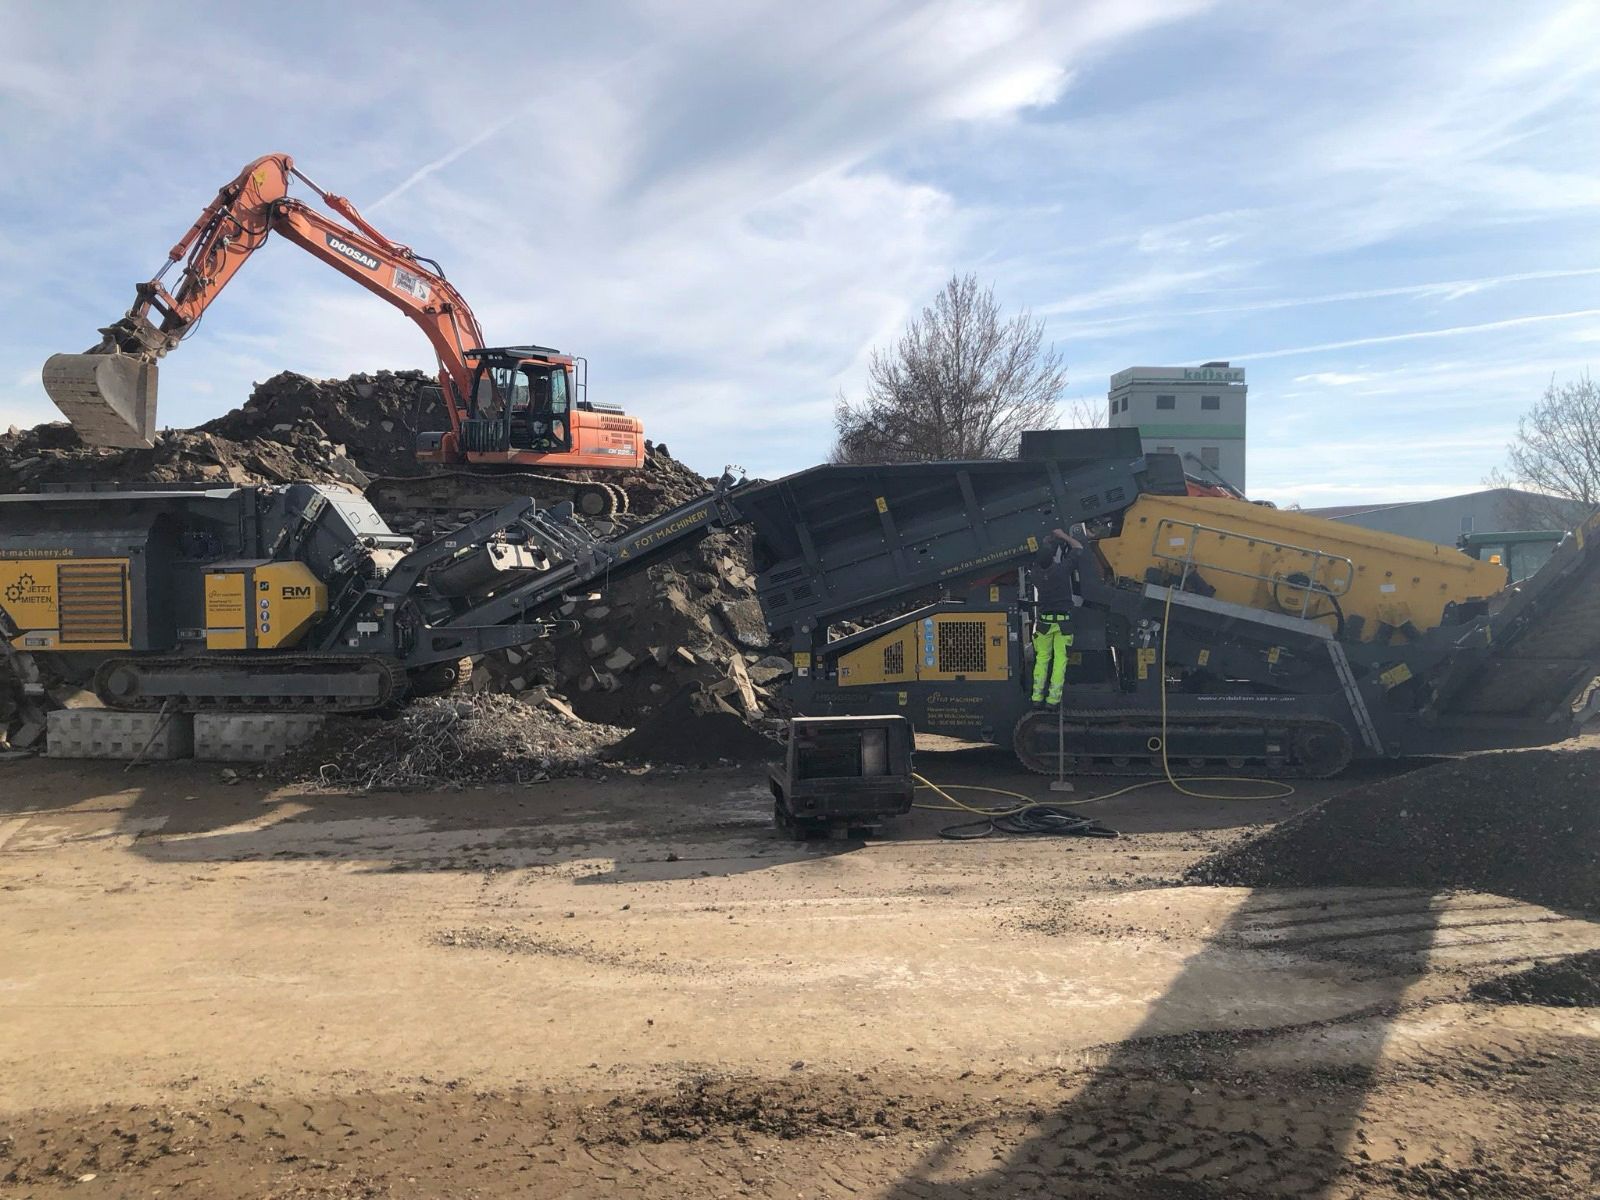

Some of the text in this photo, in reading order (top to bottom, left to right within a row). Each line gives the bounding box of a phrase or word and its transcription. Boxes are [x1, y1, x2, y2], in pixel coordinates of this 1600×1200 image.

[329, 238, 377, 268] DOOSAN
[634, 508, 709, 550] FOT MACHINERY
[0, 549, 74, 558] t-machinery.de
[282, 586, 311, 596] RM
